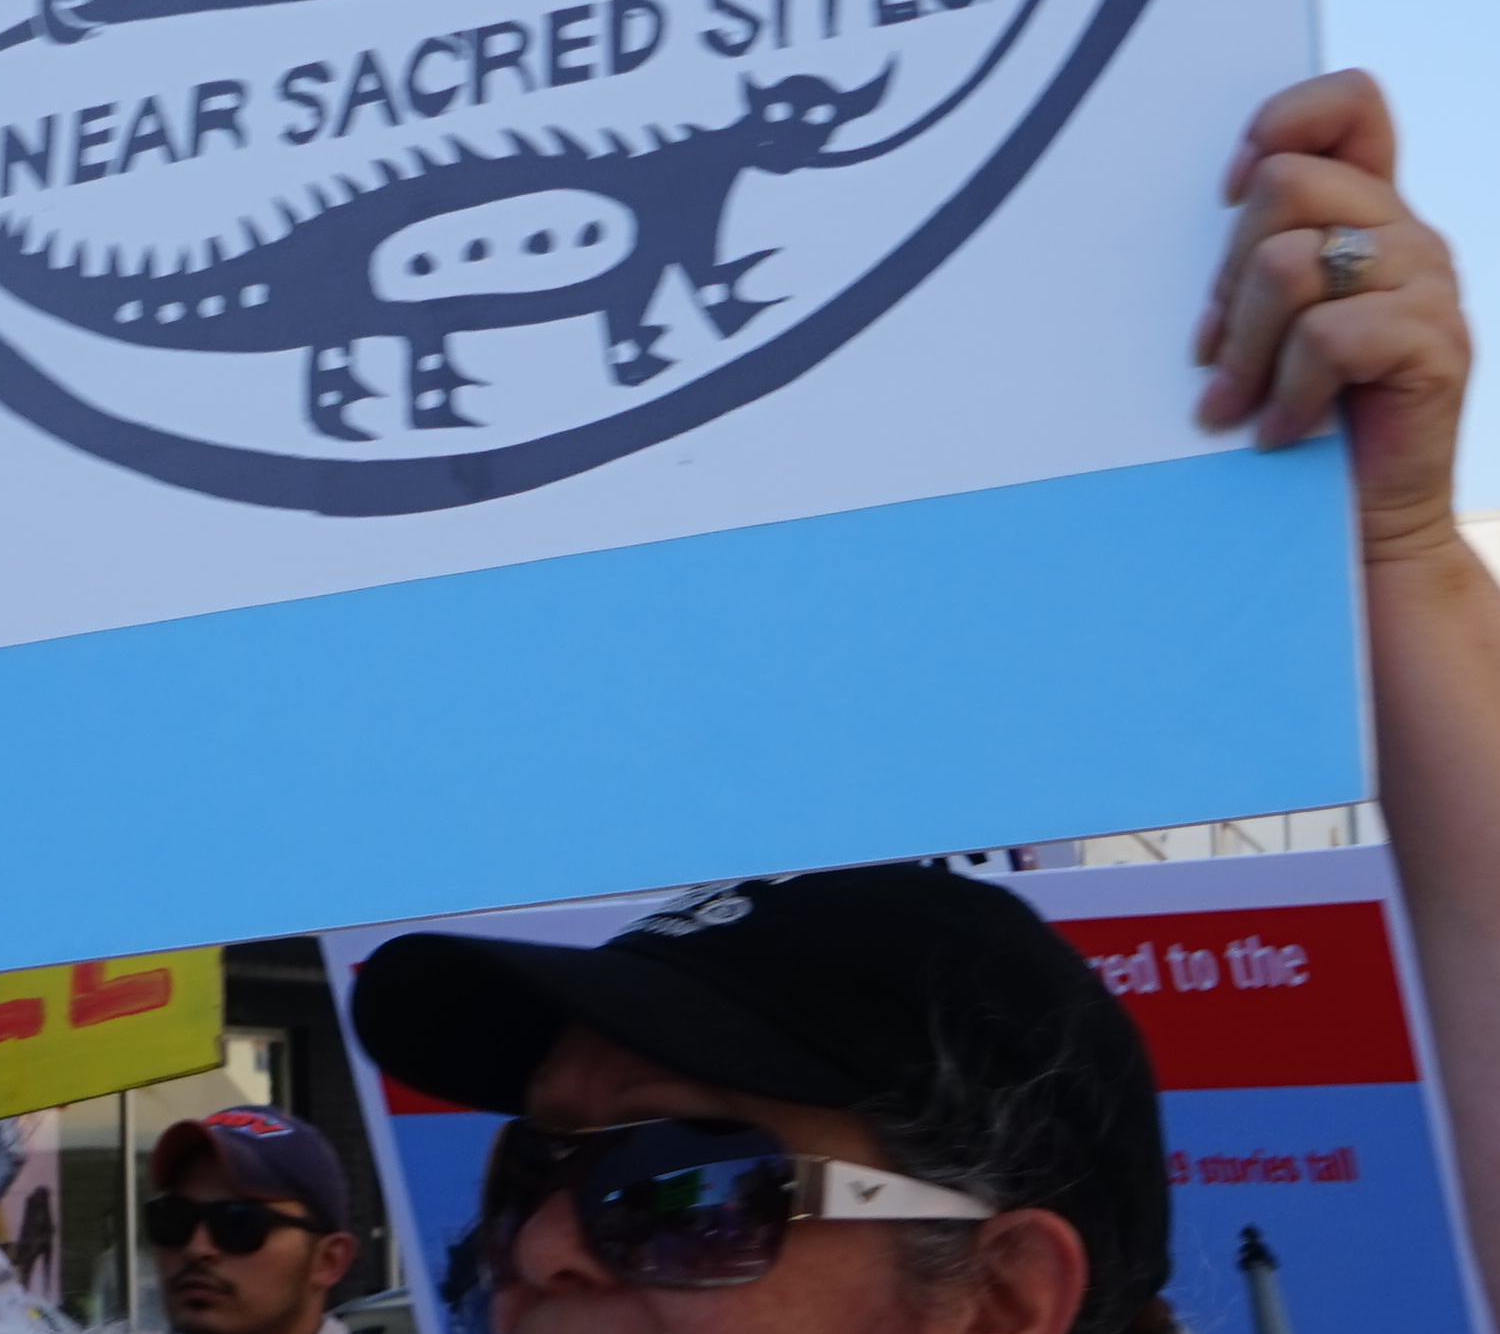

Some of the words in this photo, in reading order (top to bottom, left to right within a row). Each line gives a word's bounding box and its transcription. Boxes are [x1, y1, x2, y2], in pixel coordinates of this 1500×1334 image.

[1165, 941, 1218, 992] to
[1225, 934, 1312, 991] the
[1197, 1148, 1299, 1185] stories
[1307, 1145, 1359, 1183] tall
